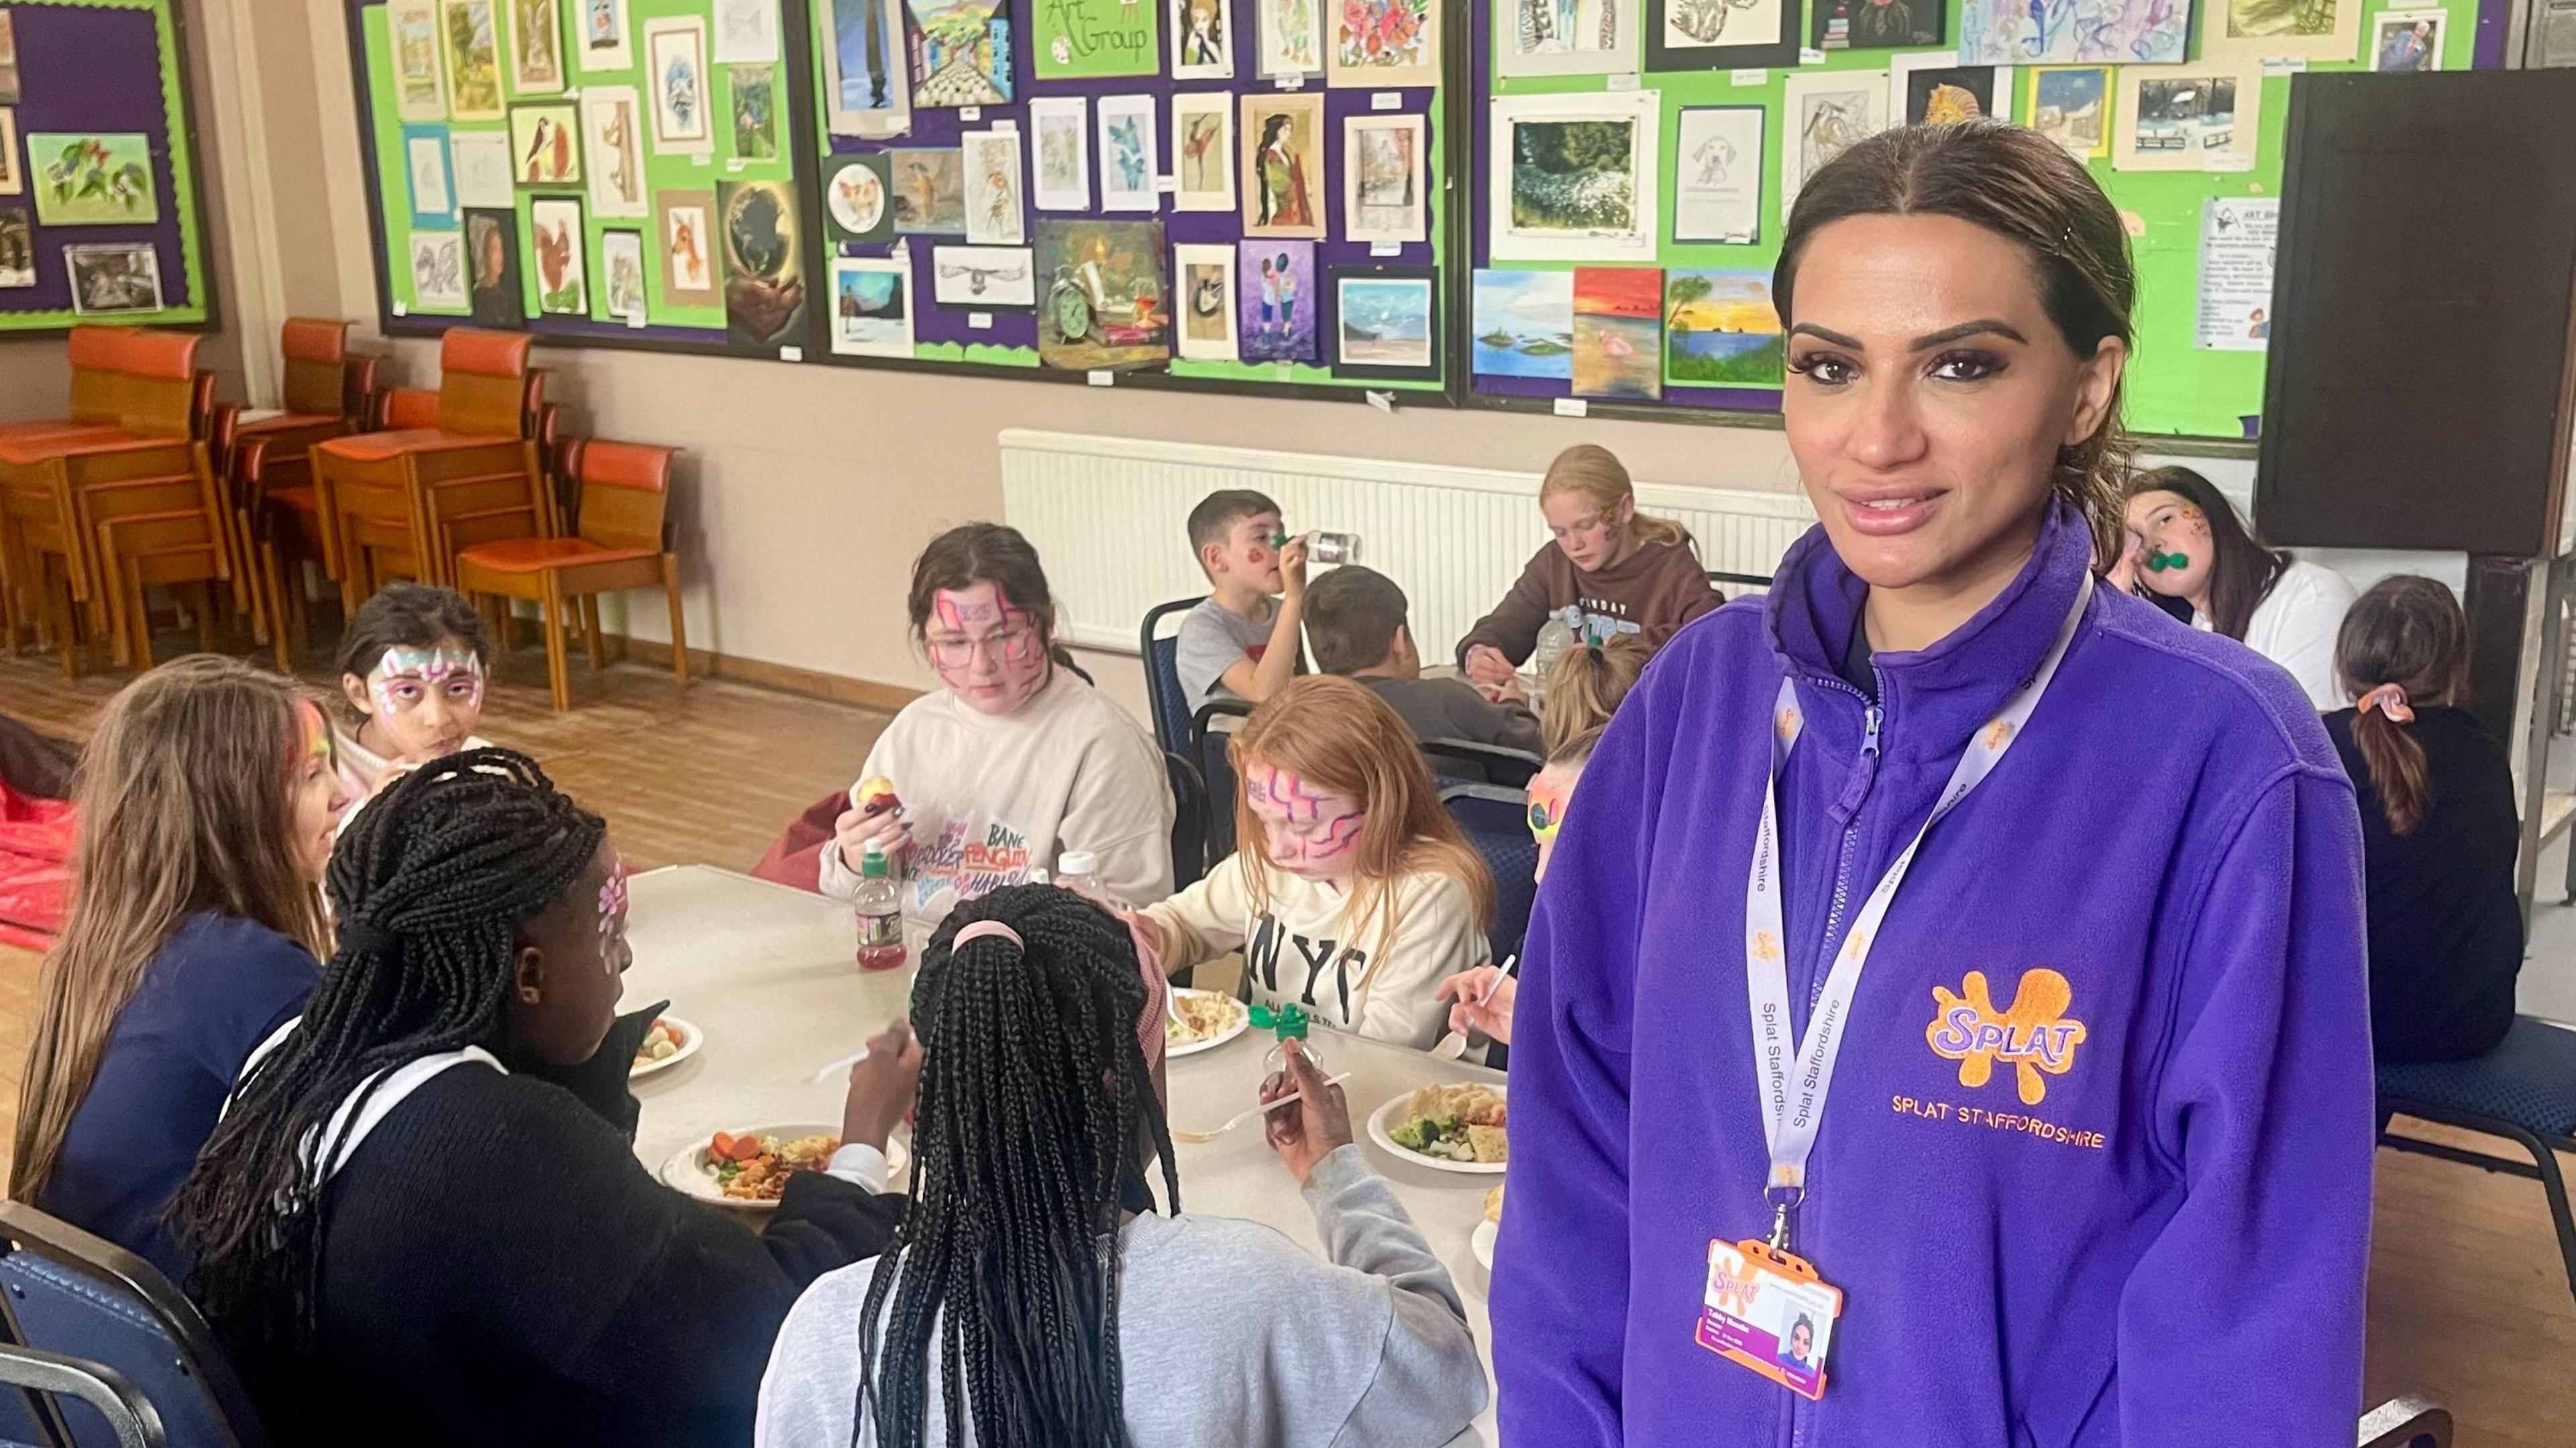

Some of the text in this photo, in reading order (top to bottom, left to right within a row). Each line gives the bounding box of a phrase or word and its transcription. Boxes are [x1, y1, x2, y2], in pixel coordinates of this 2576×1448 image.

[1081, 16, 1148, 63] Group
[1250, 910, 1366, 1025] NYC
[1762, 1003, 1778, 1041] Splat
[1935, 1006, 2078, 1066] SPLAT
[1793, 999, 1839, 1128] Splat Staffordshire
[1892, 1095, 2106, 1149] SPLAT STAFFORDSHIRE
[1713, 1271, 1758, 1303] SPLAT
